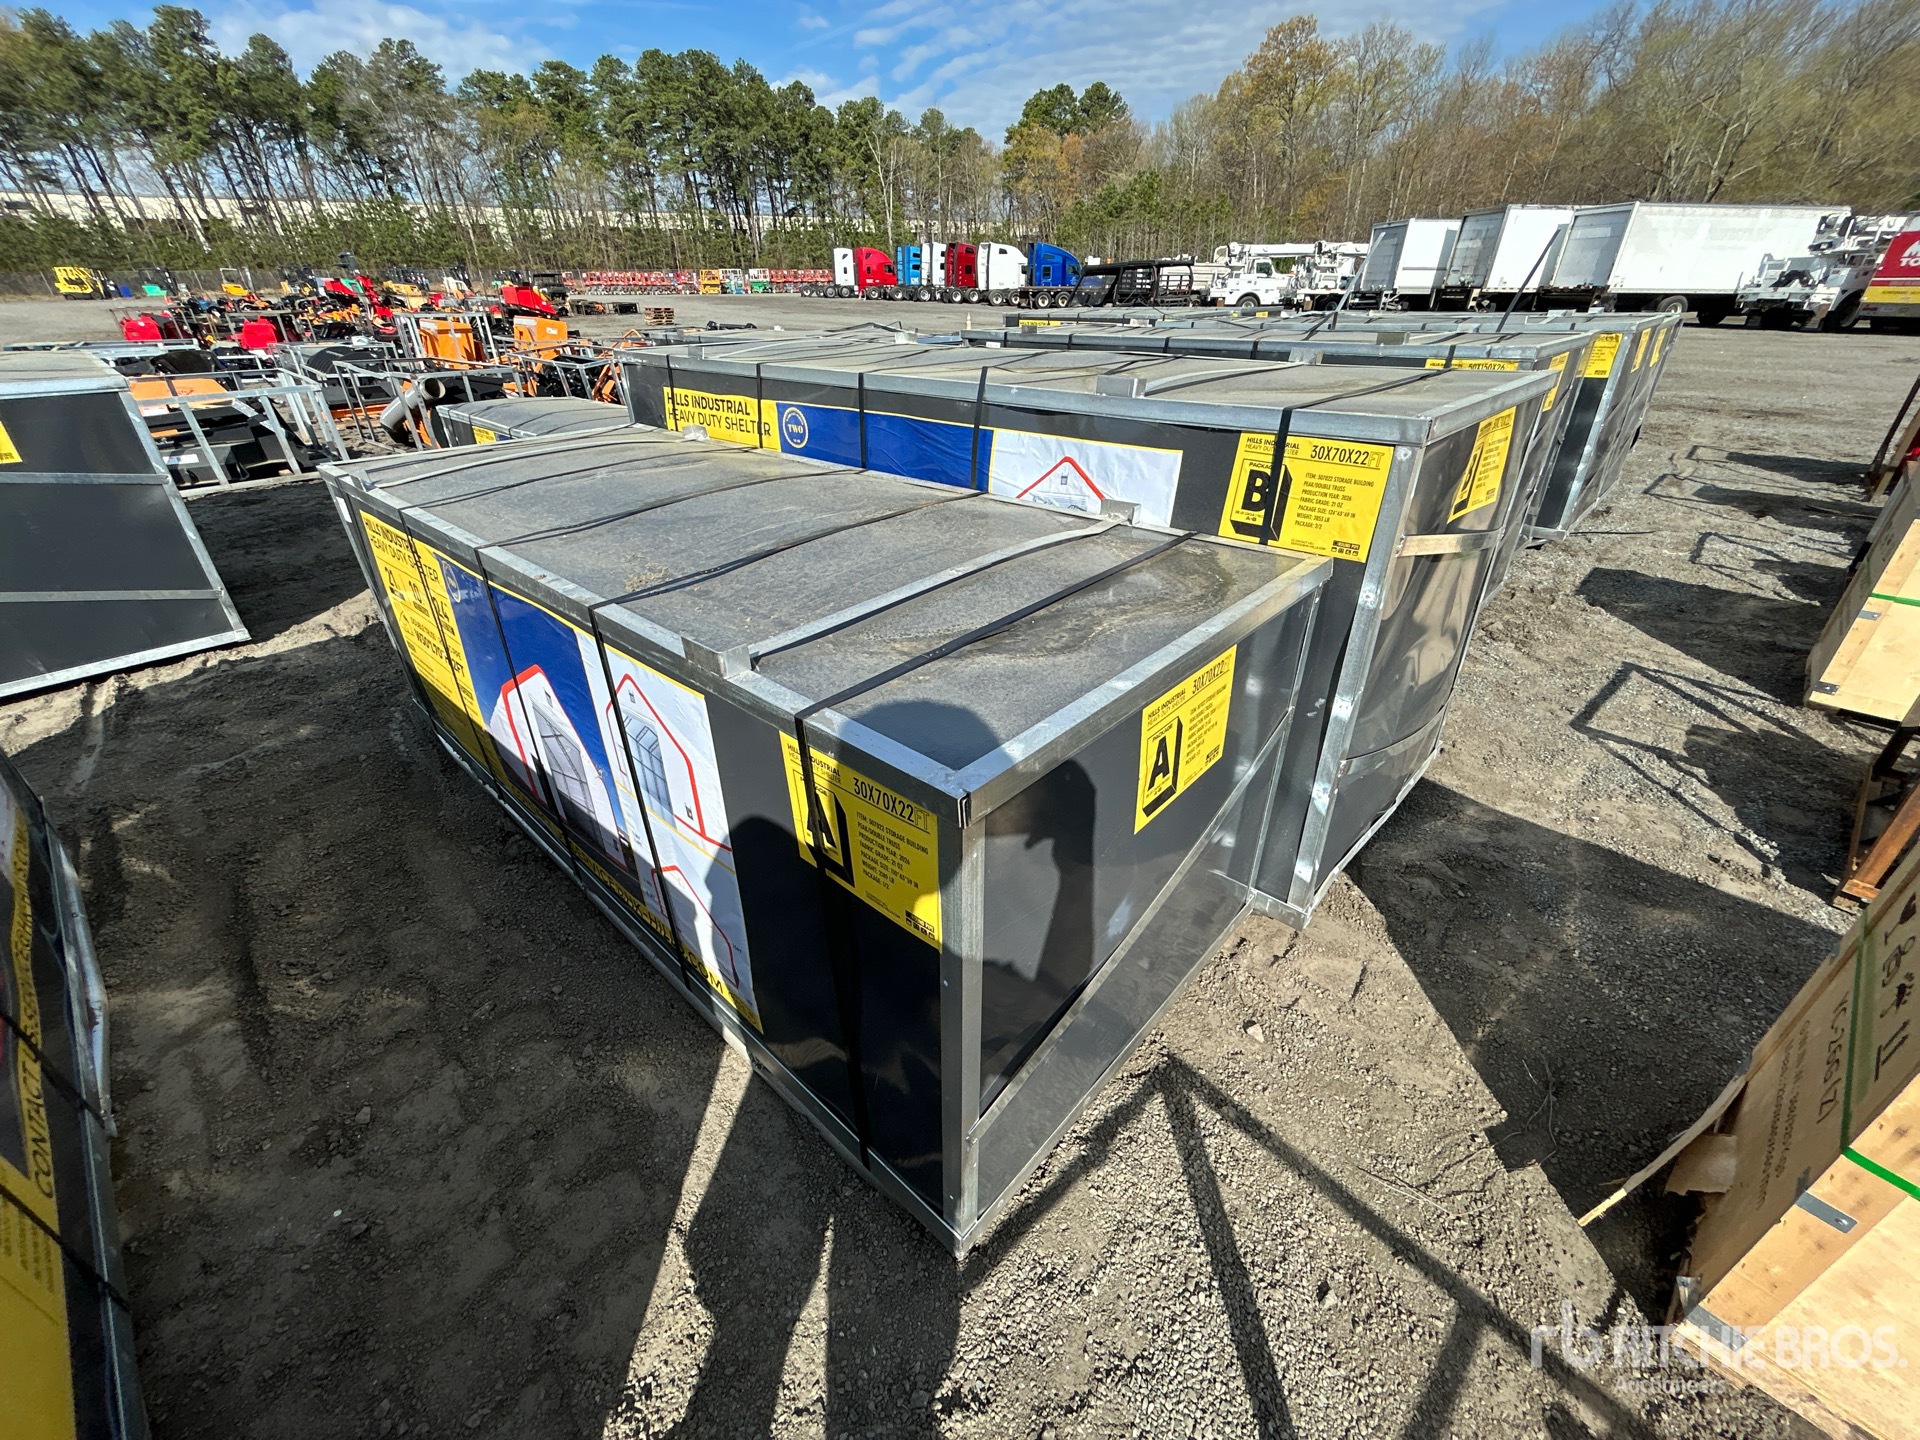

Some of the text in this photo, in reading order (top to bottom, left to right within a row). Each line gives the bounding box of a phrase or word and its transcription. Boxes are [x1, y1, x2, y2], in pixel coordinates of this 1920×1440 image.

[667, 391, 750, 417] HLLS INDUSTRIAL
[668, 407, 695, 424] HEAVY
[697, 412, 721, 428] DUTY
[725, 417, 772, 436] SHELTR
[787, 423, 804, 434] TWO
[1263, 439, 1300, 449] INDRIAL
[1241, 468, 1272, 512] B
[1333, 476, 1352, 484] STORAGE
[1352, 479, 1374, 487] BUILDING
[1301, 488, 1328, 497] PRODUCTION
[1297, 504, 1316, 512] PACKAGE
[1147, 705, 1160, 721] HILLS
[1160, 687, 1186, 711] INDUSTRIAL
[810, 755, 841, 777] DUSTRIAL
[1147, 734, 1171, 792] A
[858, 830, 884, 851] PRODUCTION
[885, 826, 905, 843] STORAGE
[906, 837, 928, 855] BUILDING
[886, 836, 900, 850] TRUSS
[860, 849, 878, 865] PACKAGE
[21, 1058, 54, 1199] CONTACT
